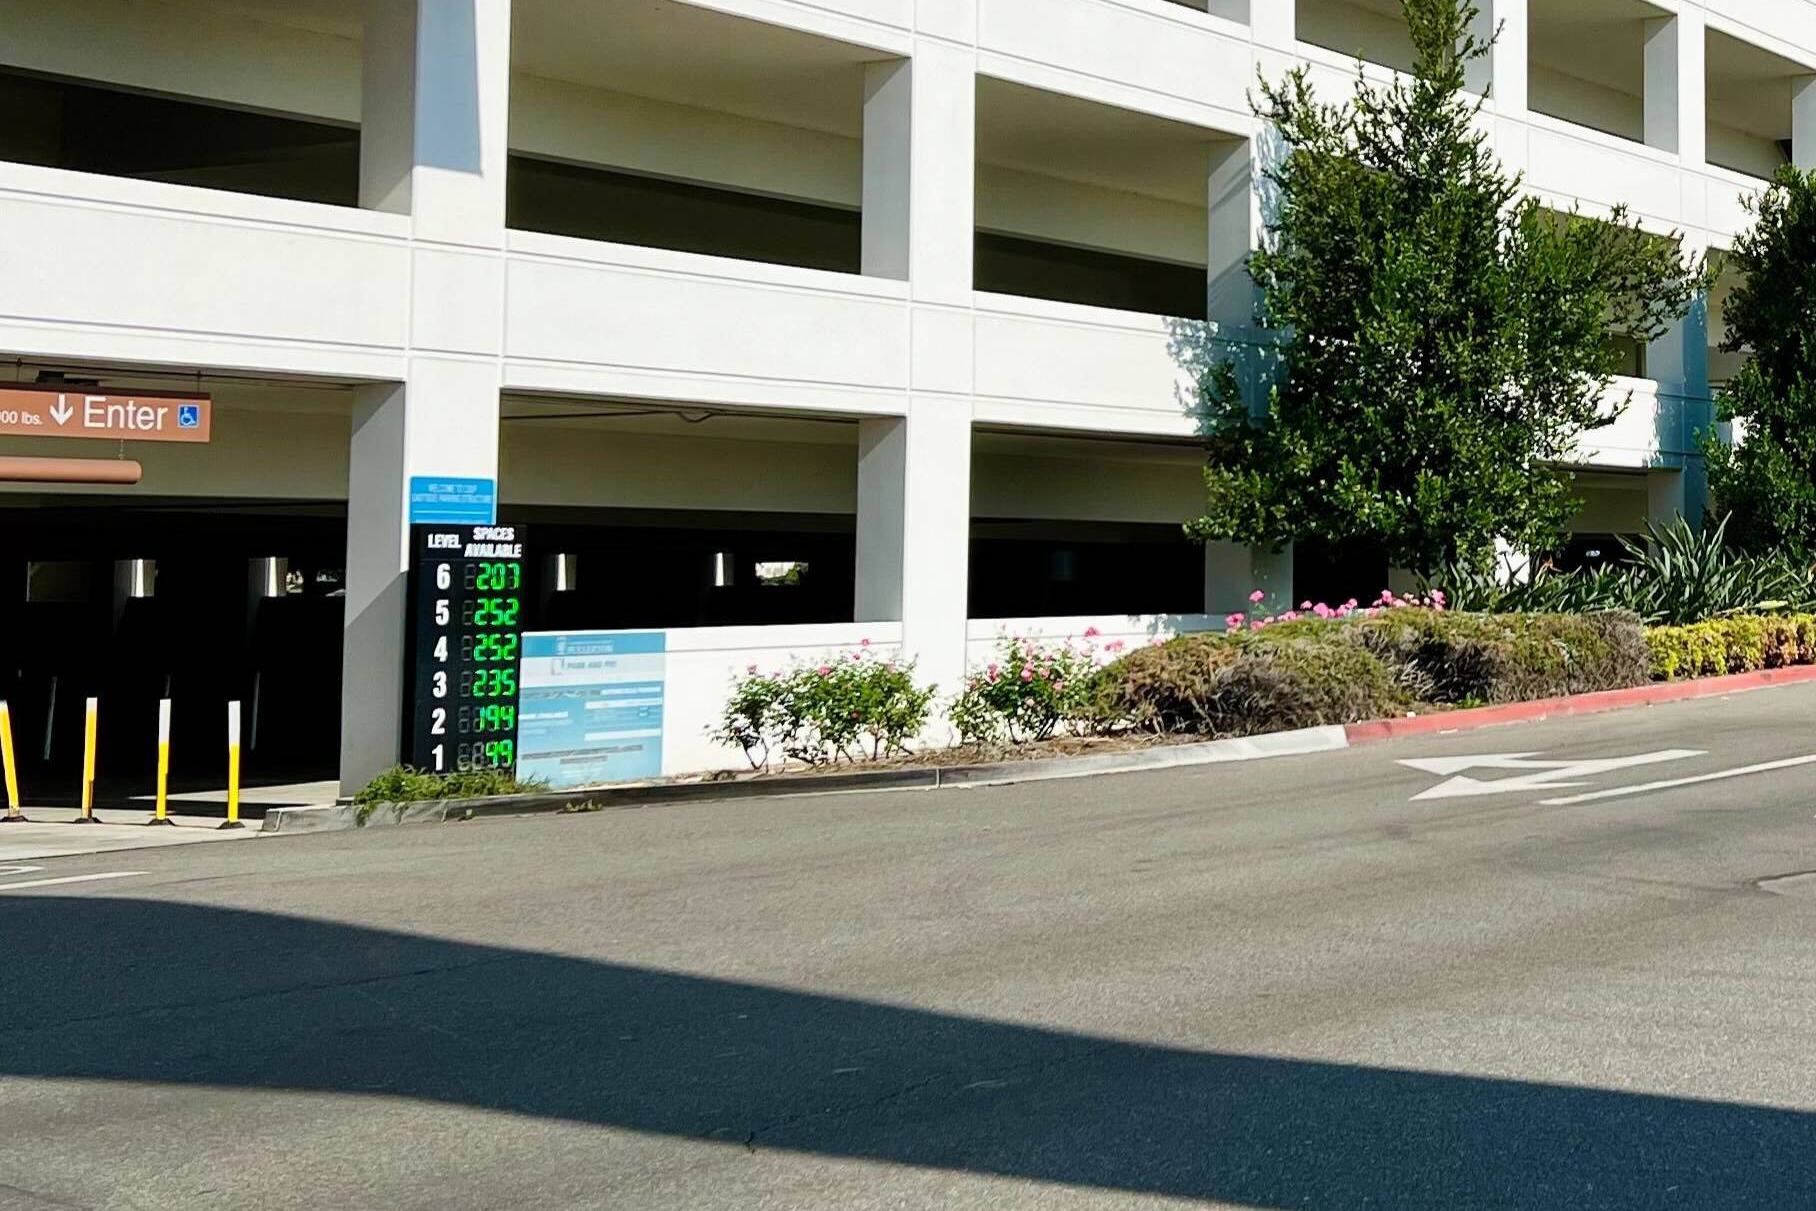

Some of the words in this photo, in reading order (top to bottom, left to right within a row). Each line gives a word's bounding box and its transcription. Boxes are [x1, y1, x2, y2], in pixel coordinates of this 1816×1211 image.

[0, 410, 18, 424] 00
[21, 410, 43, 426] lbs.
[84, 395, 168, 430] Enter
[427, 534, 462, 548] LEVEL
[473, 526, 515, 541] SPACES
[464, 543, 522, 558] AVAILABLE
[437, 563, 451, 590] 6
[476, 562, 520, 590] 207
[435, 599, 450, 626] 5
[474, 598, 519, 626] 252
[433, 636, 448, 662] 4
[473, 633, 518, 661] 252
[432, 671, 447, 698] 3
[473, 669, 516, 697] 235
[431, 707, 446, 735] 2
[431, 743, 443, 771] 1
